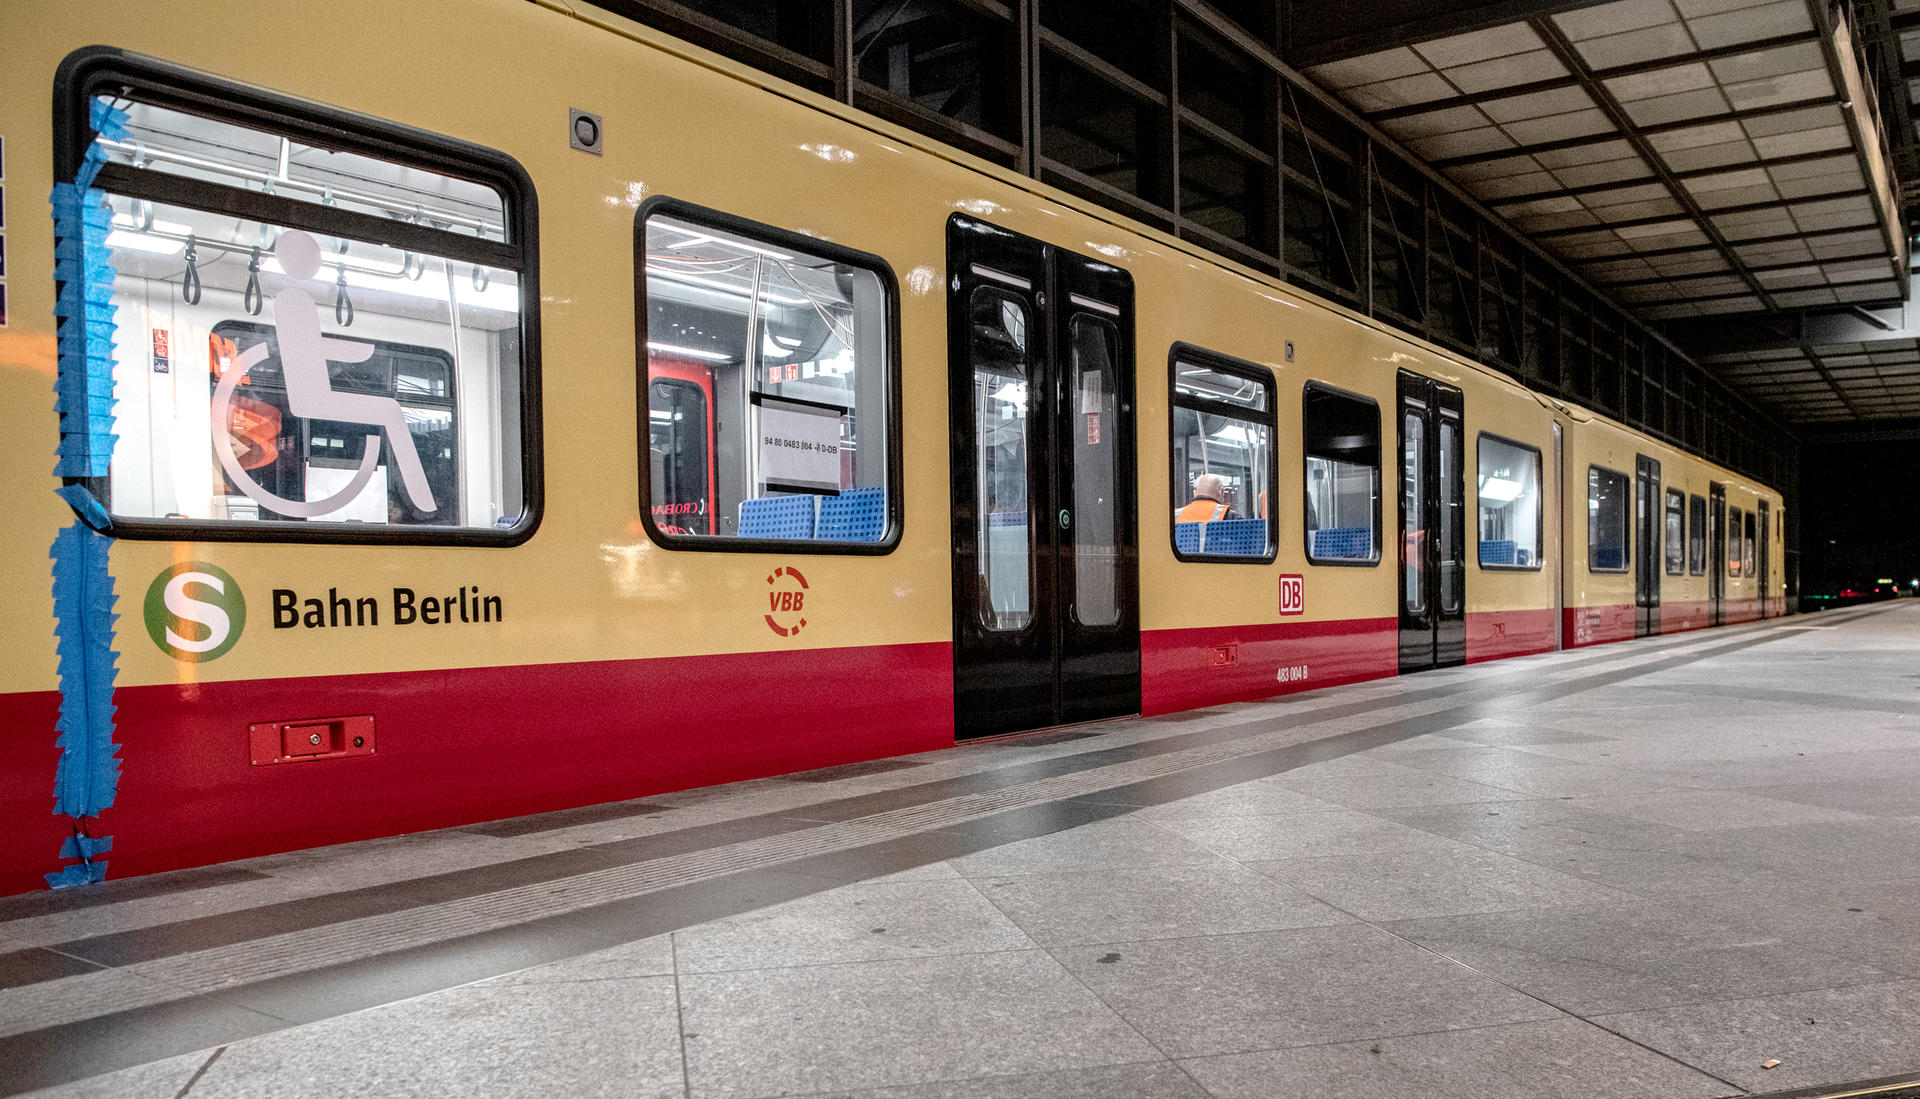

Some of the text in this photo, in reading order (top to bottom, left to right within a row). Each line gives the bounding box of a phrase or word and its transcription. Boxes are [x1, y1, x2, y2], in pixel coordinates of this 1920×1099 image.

[764, 436, 773, 445] 94
[783, 439, 800, 449] 0483
[769, 591, 804, 612] VBB
[1282, 581, 1302, 609] DB
[163, 571, 503, 654] S Bahn Berlin
[1277, 665, 1308, 682] 483 004 B
